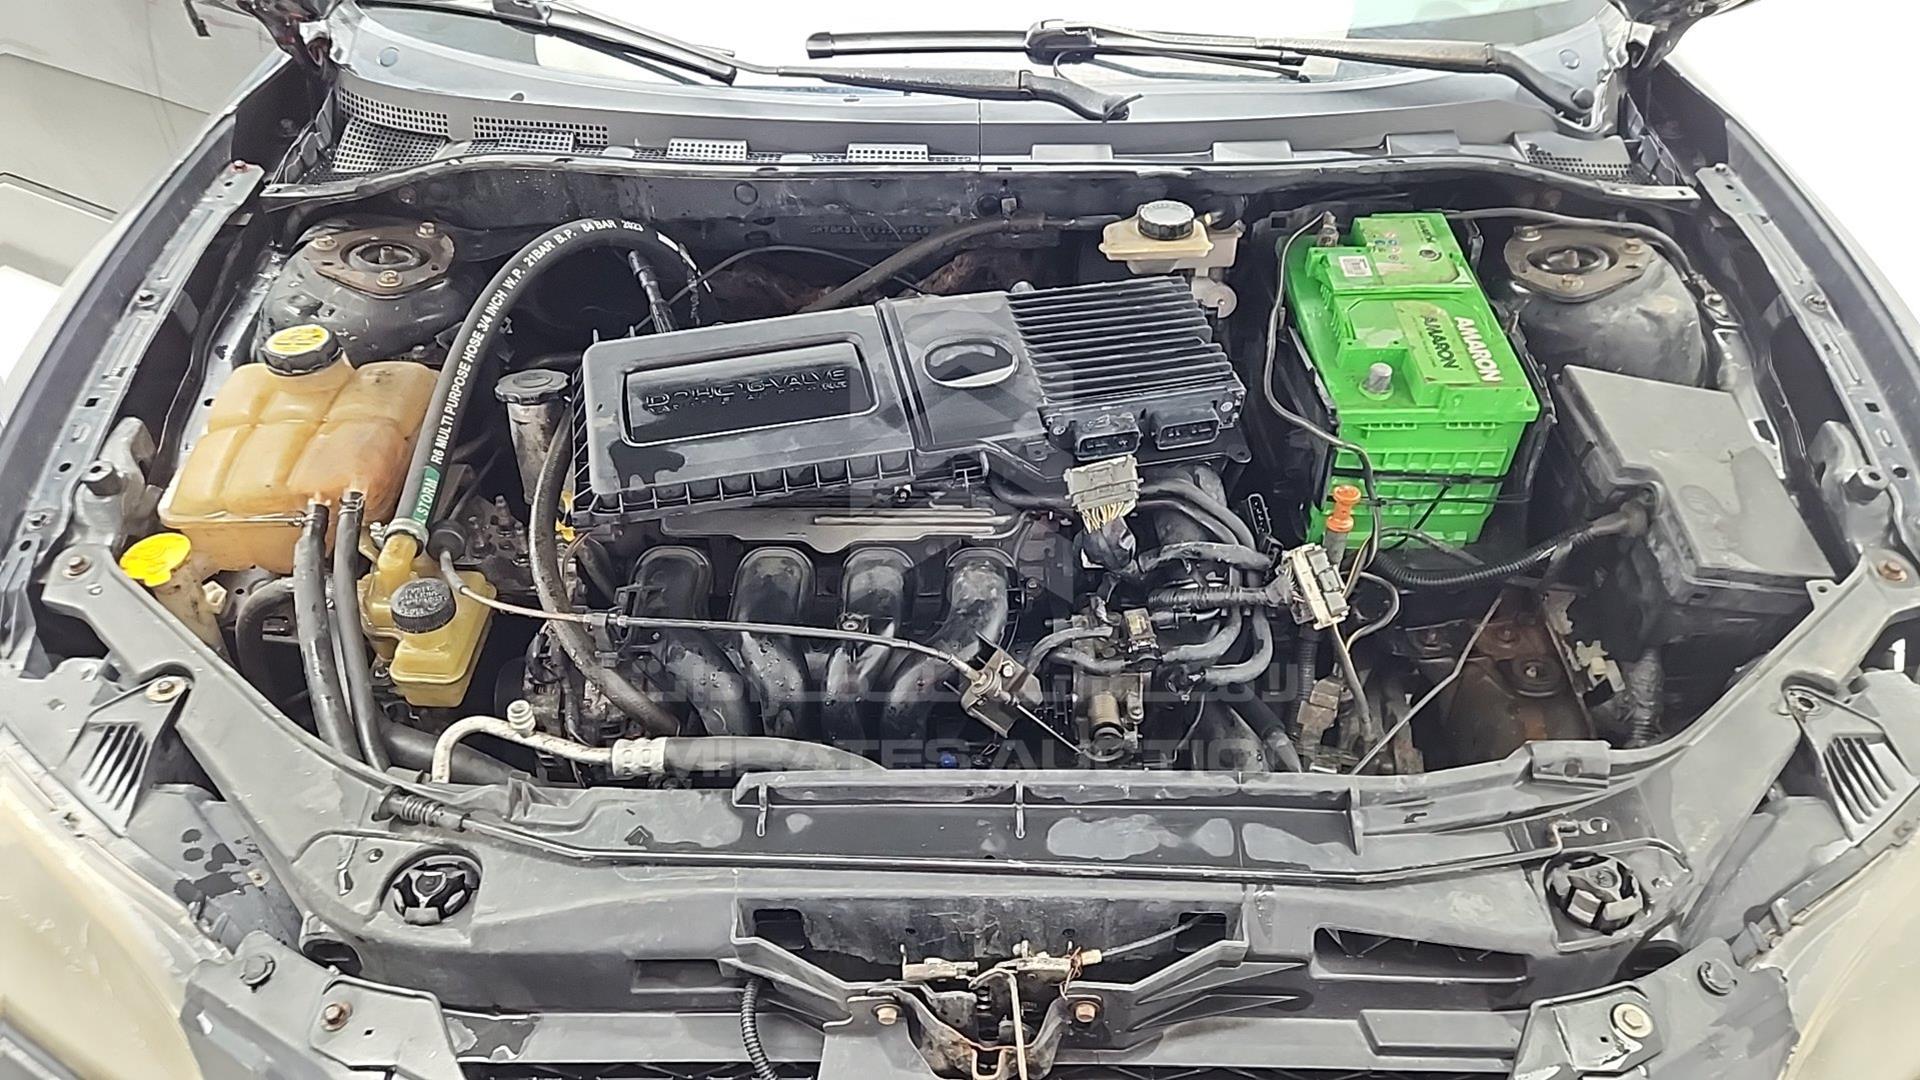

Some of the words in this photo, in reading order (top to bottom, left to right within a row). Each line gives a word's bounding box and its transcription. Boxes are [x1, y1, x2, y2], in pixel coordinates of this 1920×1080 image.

[595, 219, 618, 230] BAR
[485, 289, 509, 317] INCH
[476, 314, 493, 332] 3/4
[461, 330, 485, 363] HOSE
[1454, 316, 1505, 382] AMARON
[444, 361, 472, 416] PURPOSE
[434, 415, 455, 450] MULTI
[430, 448, 445, 465] R6
[416, 477, 438, 516] STORM
